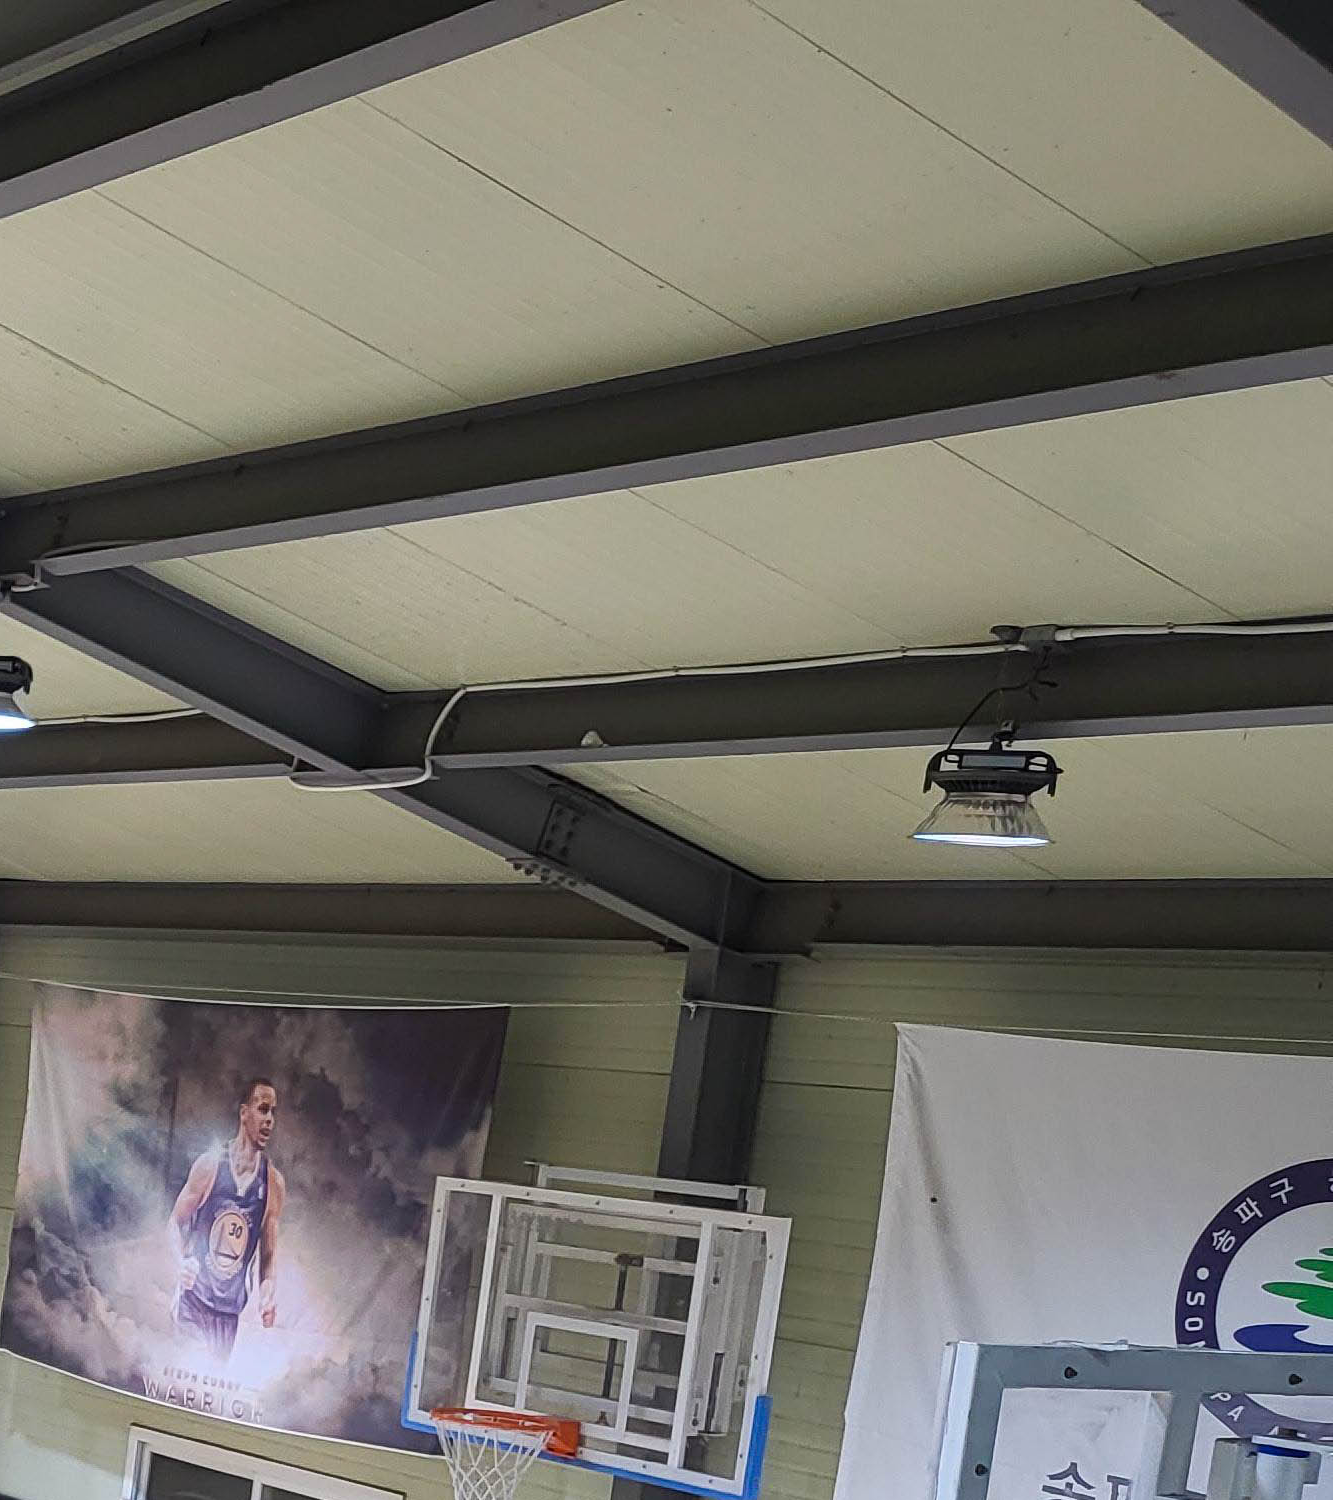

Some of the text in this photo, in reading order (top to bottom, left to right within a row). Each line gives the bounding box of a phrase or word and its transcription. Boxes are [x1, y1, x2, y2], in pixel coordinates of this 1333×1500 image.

[228, 1222, 244, 1239] 30
[1211, 1177, 1294, 1254] 송파구
[141, 1375, 264, 1423] WARRIOR
